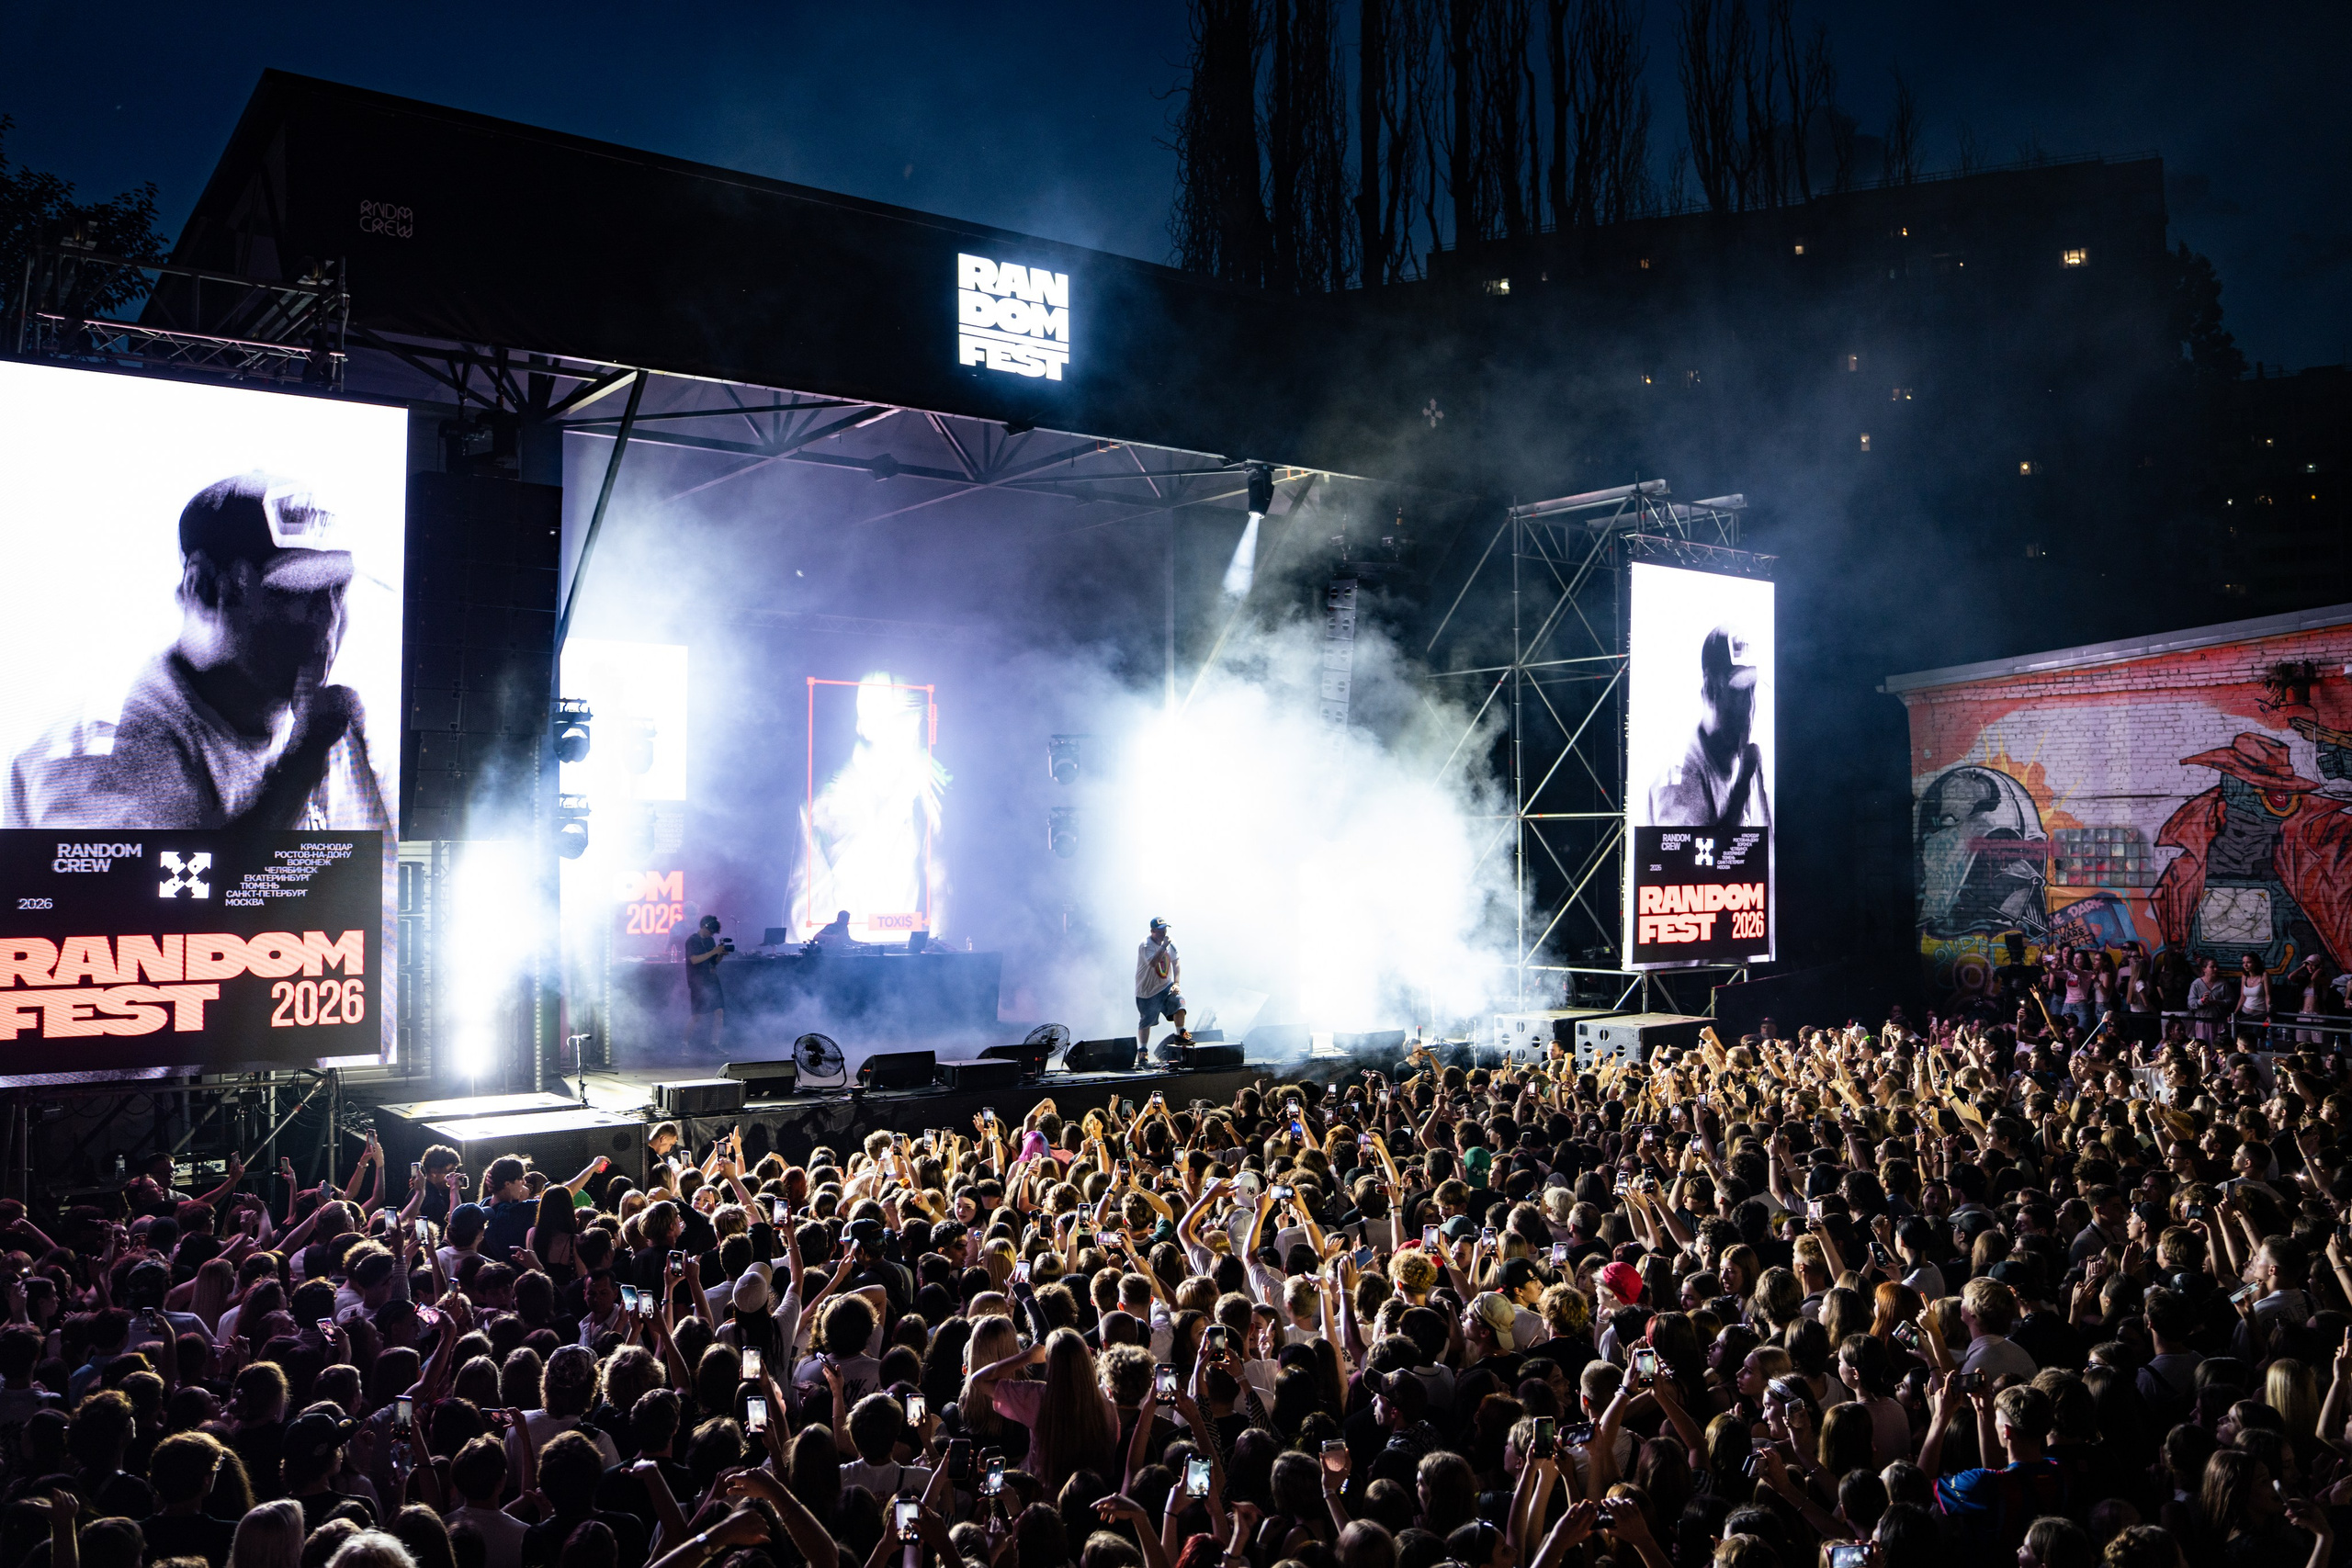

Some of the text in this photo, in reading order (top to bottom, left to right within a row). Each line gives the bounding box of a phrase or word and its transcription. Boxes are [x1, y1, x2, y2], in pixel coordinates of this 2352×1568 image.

[360, 216, 413, 238] CREW
[958, 253, 1069, 309] RAN
[958, 288, 1069, 343] DOM
[959, 333, 1069, 381] FEST
[1662, 833, 1690, 842] RANDOM
[57, 843, 142, 858] RANDOM
[300, 843, 353, 852] КРАСНОДАР
[1661, 842, 1681, 851] CREW
[275, 851, 352, 859] РОСТОВ-НА-ДОНУ
[51, 858, 111, 873] CREW
[243, 874, 311, 882] ЕКАТЕРИНБУРГ
[225, 889, 308, 897] САНКТ-ПЕТЕРБУРГ
[240, 882, 280, 890] ТЮМЕНЬ
[17, 898, 53, 909] 2026
[225, 898, 265, 907] МОСКВА
[1639, 883, 1764, 915] RANDOM
[2067, 899, 2105, 918] DARK
[627, 903, 684, 934] 2026
[877, 915, 913, 928] TOXI$
[1638, 911, 1765, 944] FEST 2026
[2059, 928, 2085, 942] WARS
[0, 930, 365, 987] RANDOM
[0, 979, 365, 1040] FEST 2026
